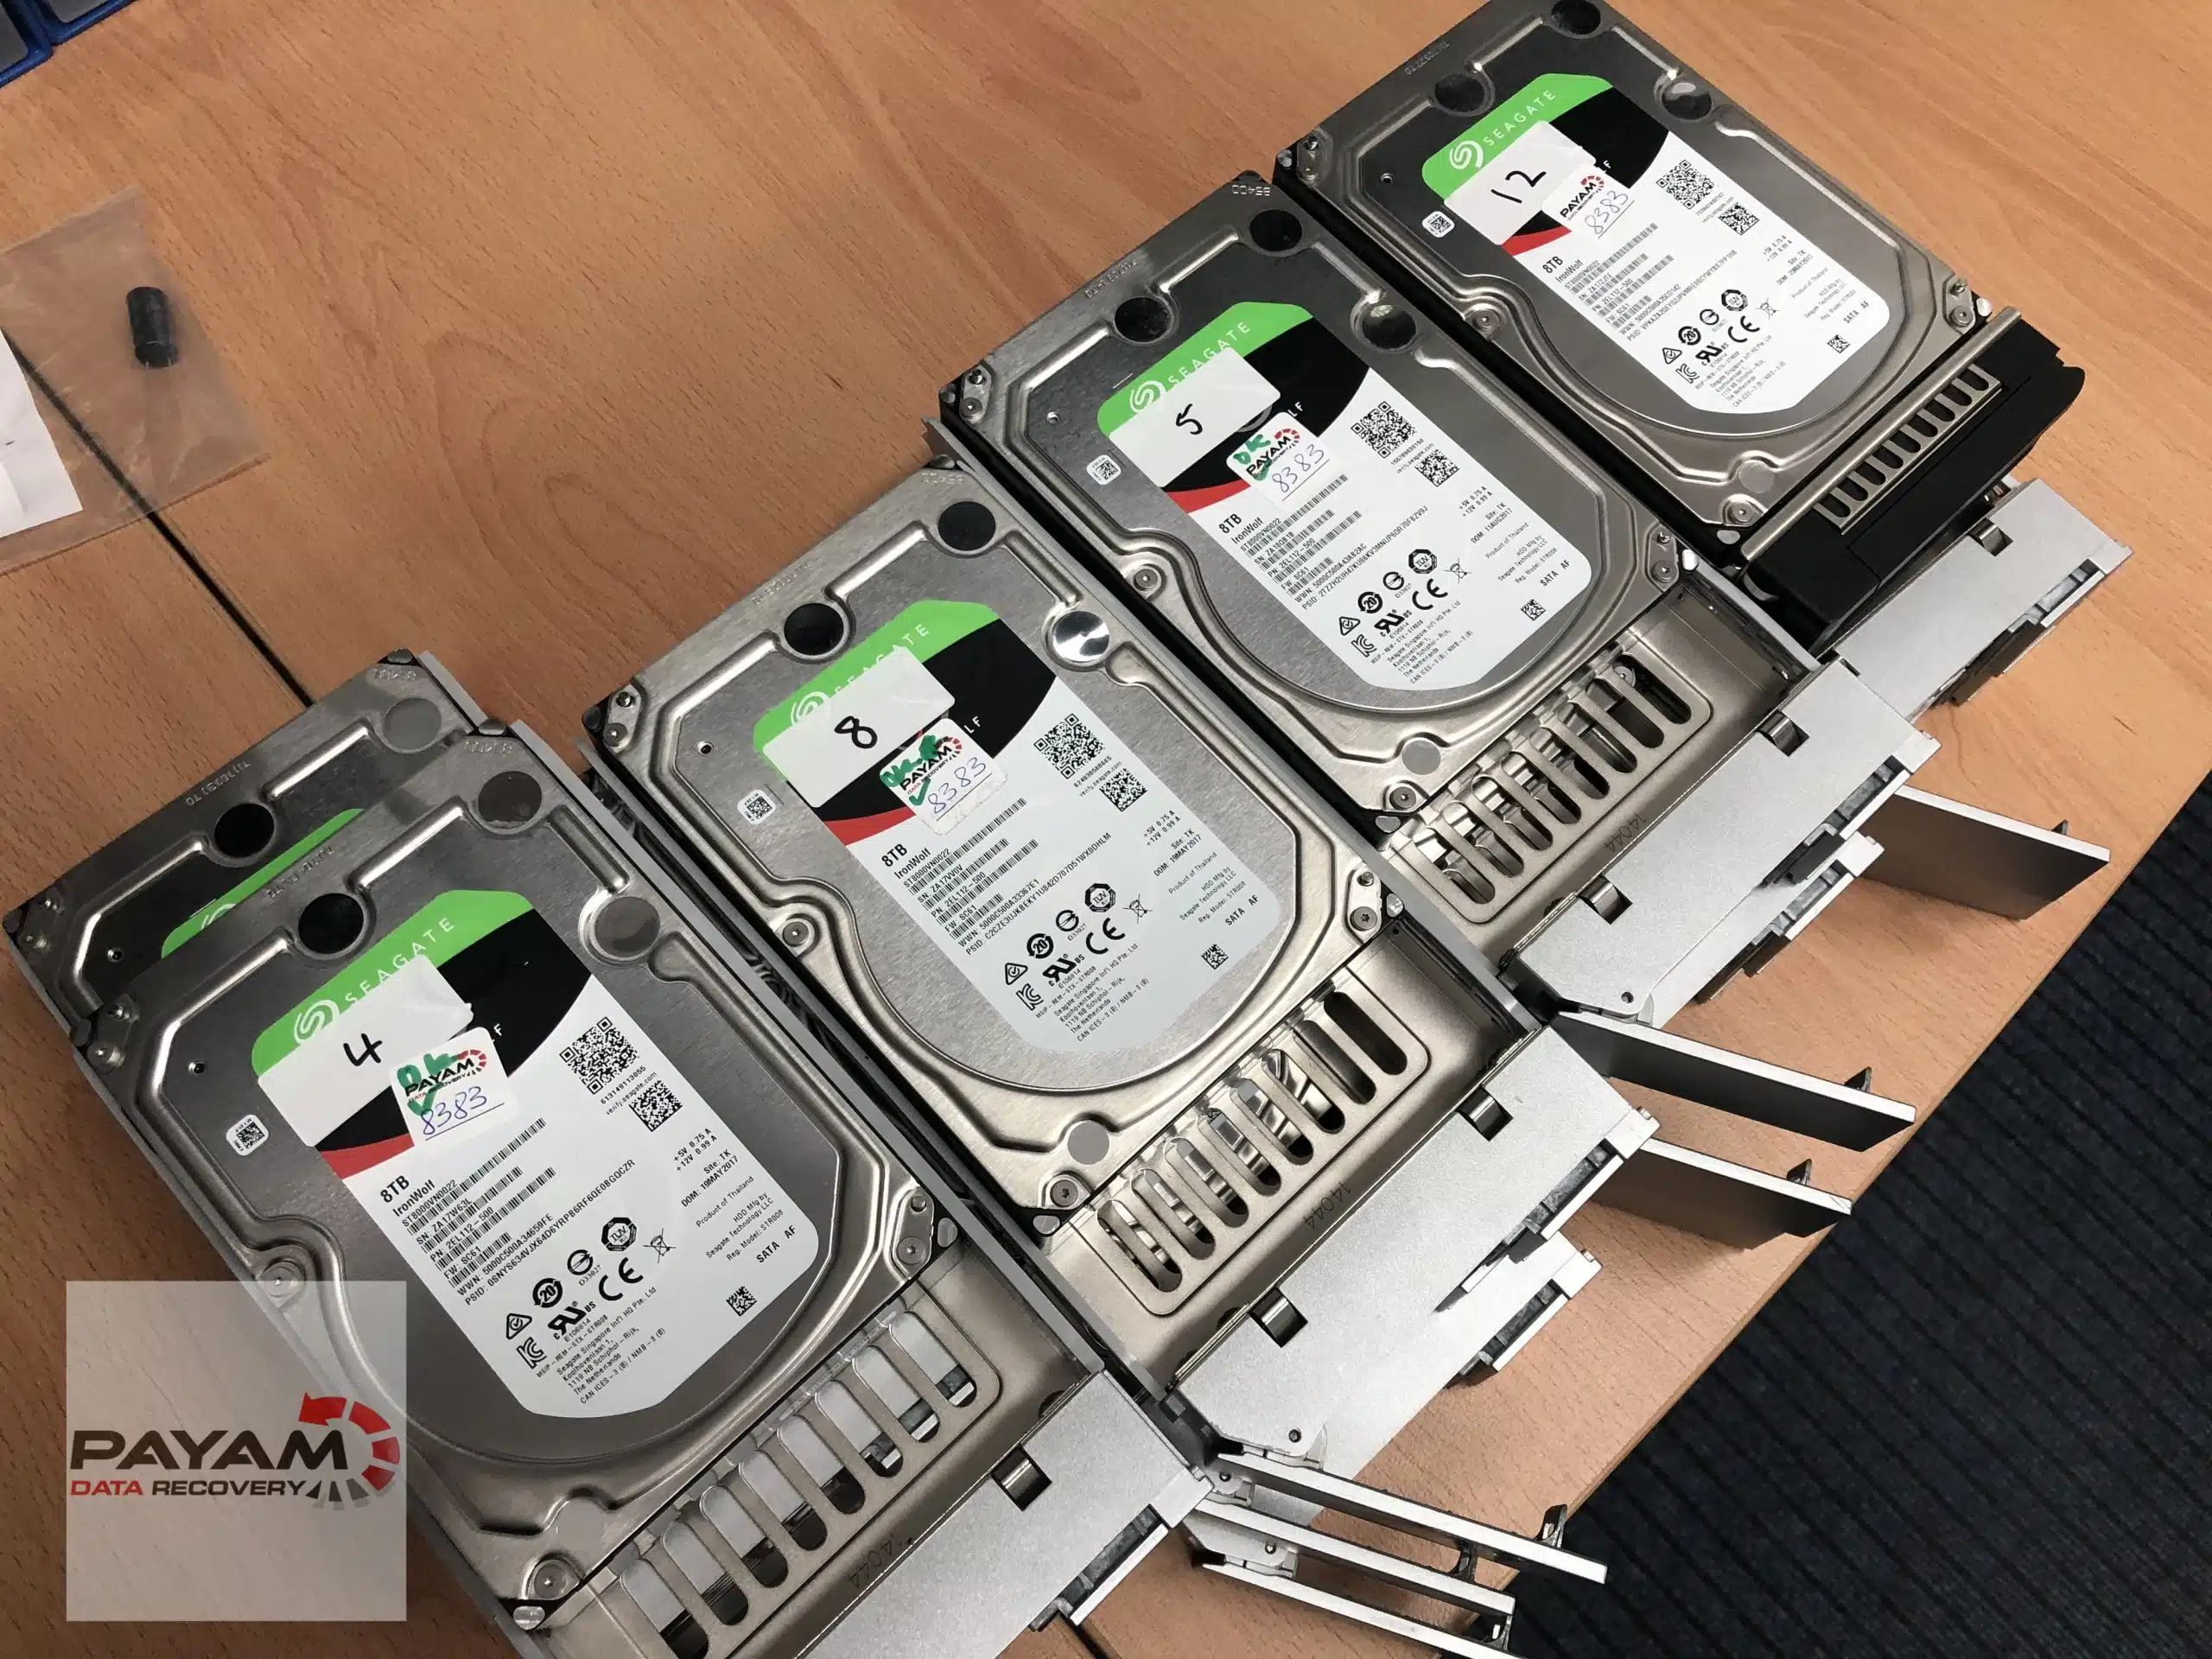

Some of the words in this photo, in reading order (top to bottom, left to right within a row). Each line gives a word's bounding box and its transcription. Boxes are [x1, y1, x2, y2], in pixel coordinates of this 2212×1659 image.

[1483, 90, 1556, 146] SEAGATE
[1491, 170, 1548, 204] 12
[1560, 182, 1597, 218] PAYAM
[1585, 190, 1629, 235] 8383
[1541, 256, 1563, 274] 8TB
[1554, 258, 1584, 283] IronWolf
[1175, 404, 1204, 435] 5
[1246, 435, 1292, 476] PAYAM
[1272, 443, 1324, 493] 8383
[1218, 513, 1242, 534] 8TB
[1230, 516, 1263, 544] IronWolf
[1539, 570, 1559, 587] SATA
[1560, 559, 1570, 570] AF
[834, 715, 878, 749] 8
[899, 746, 952, 791] PAYAM
[927, 757, 986, 814] 8383
[1169, 834, 1201, 863] 19MAY2017
[1183, 828, 1195, 838] TK
[880, 843, 907, 868] 8TB
[893, 847, 931, 880] IronWolf
[903, 848, 951, 888] ST8000VN0022
[1167, 874, 1190, 895] Product
[1189, 868, 1196, 878] of
[1193, 851, 1217, 872] Thailand
[958, 904, 977, 921] SC61
[1224, 907, 1245, 925] SATA
[1248, 894, 1258, 906] AF
[342, 1033, 383, 1067] 4
[404, 1058, 475, 1096] PAYAM
[606, 1071, 658, 1116] verify.seagate.com
[421, 1086, 487, 1135] 8383
[673, 1147, 688, 1161] +5V
[689, 1133, 705, 1148] 0.75
[676, 1154, 694, 1171] +12V
[695, 1140, 711, 1155] 0.99
[702, 1161, 718, 1174] Site:
[718, 1148, 731, 1160] TK
[379, 1175, 410, 1203] 8TB
[392, 1179, 435, 1217] IronWolf
[681, 1189, 701, 1207] DOM:
[700, 1154, 738, 1190] 19MAY2017
[402, 1179, 457, 1227] ST8000VN0022
[695, 1204, 721, 1228] Product
[721, 1197, 728, 1206] of
[727, 1175, 754, 1199] Thailand
[732, 1209, 747, 1224] HDD
[746, 1199, 760, 1211] Mfg
[758, 1192, 768, 1201] by
[416, 1231, 429, 1245] SN:
[431, 1198, 473, 1233] ZA17W63L
[429, 1249, 444, 1262] PN:
[445, 1206, 494, 1249] 2EL112-500
[706, 1236, 730, 1258] Seagate
[728, 1209, 762, 1237] Technology
[760, 1197, 774, 1211] LLC
[456, 1274, 480, 1296] WWN:
[481, 1214, 553, 1275] 5000C500A34659FE
[726, 1249, 742, 1262] Reg.
[740, 1230, 762, 1249] Model:
[756, 1241, 780, 1263] SATA
[784, 1224, 796, 1239] AF
[443, 1263, 461, 1280] FW:
[461, 1245, 481, 1265] SC61
[598, 1256, 644, 1301] CE
[464, 1287, 485, 1306] PSID:
[537, 1282, 559, 1304] 20
[556, 1353, 582, 1376] Seagate
[580, 1326, 612, 1354] Singapore
[573, 1383, 587, 1395] The
[585, 1352, 621, 1385] Netherlands
